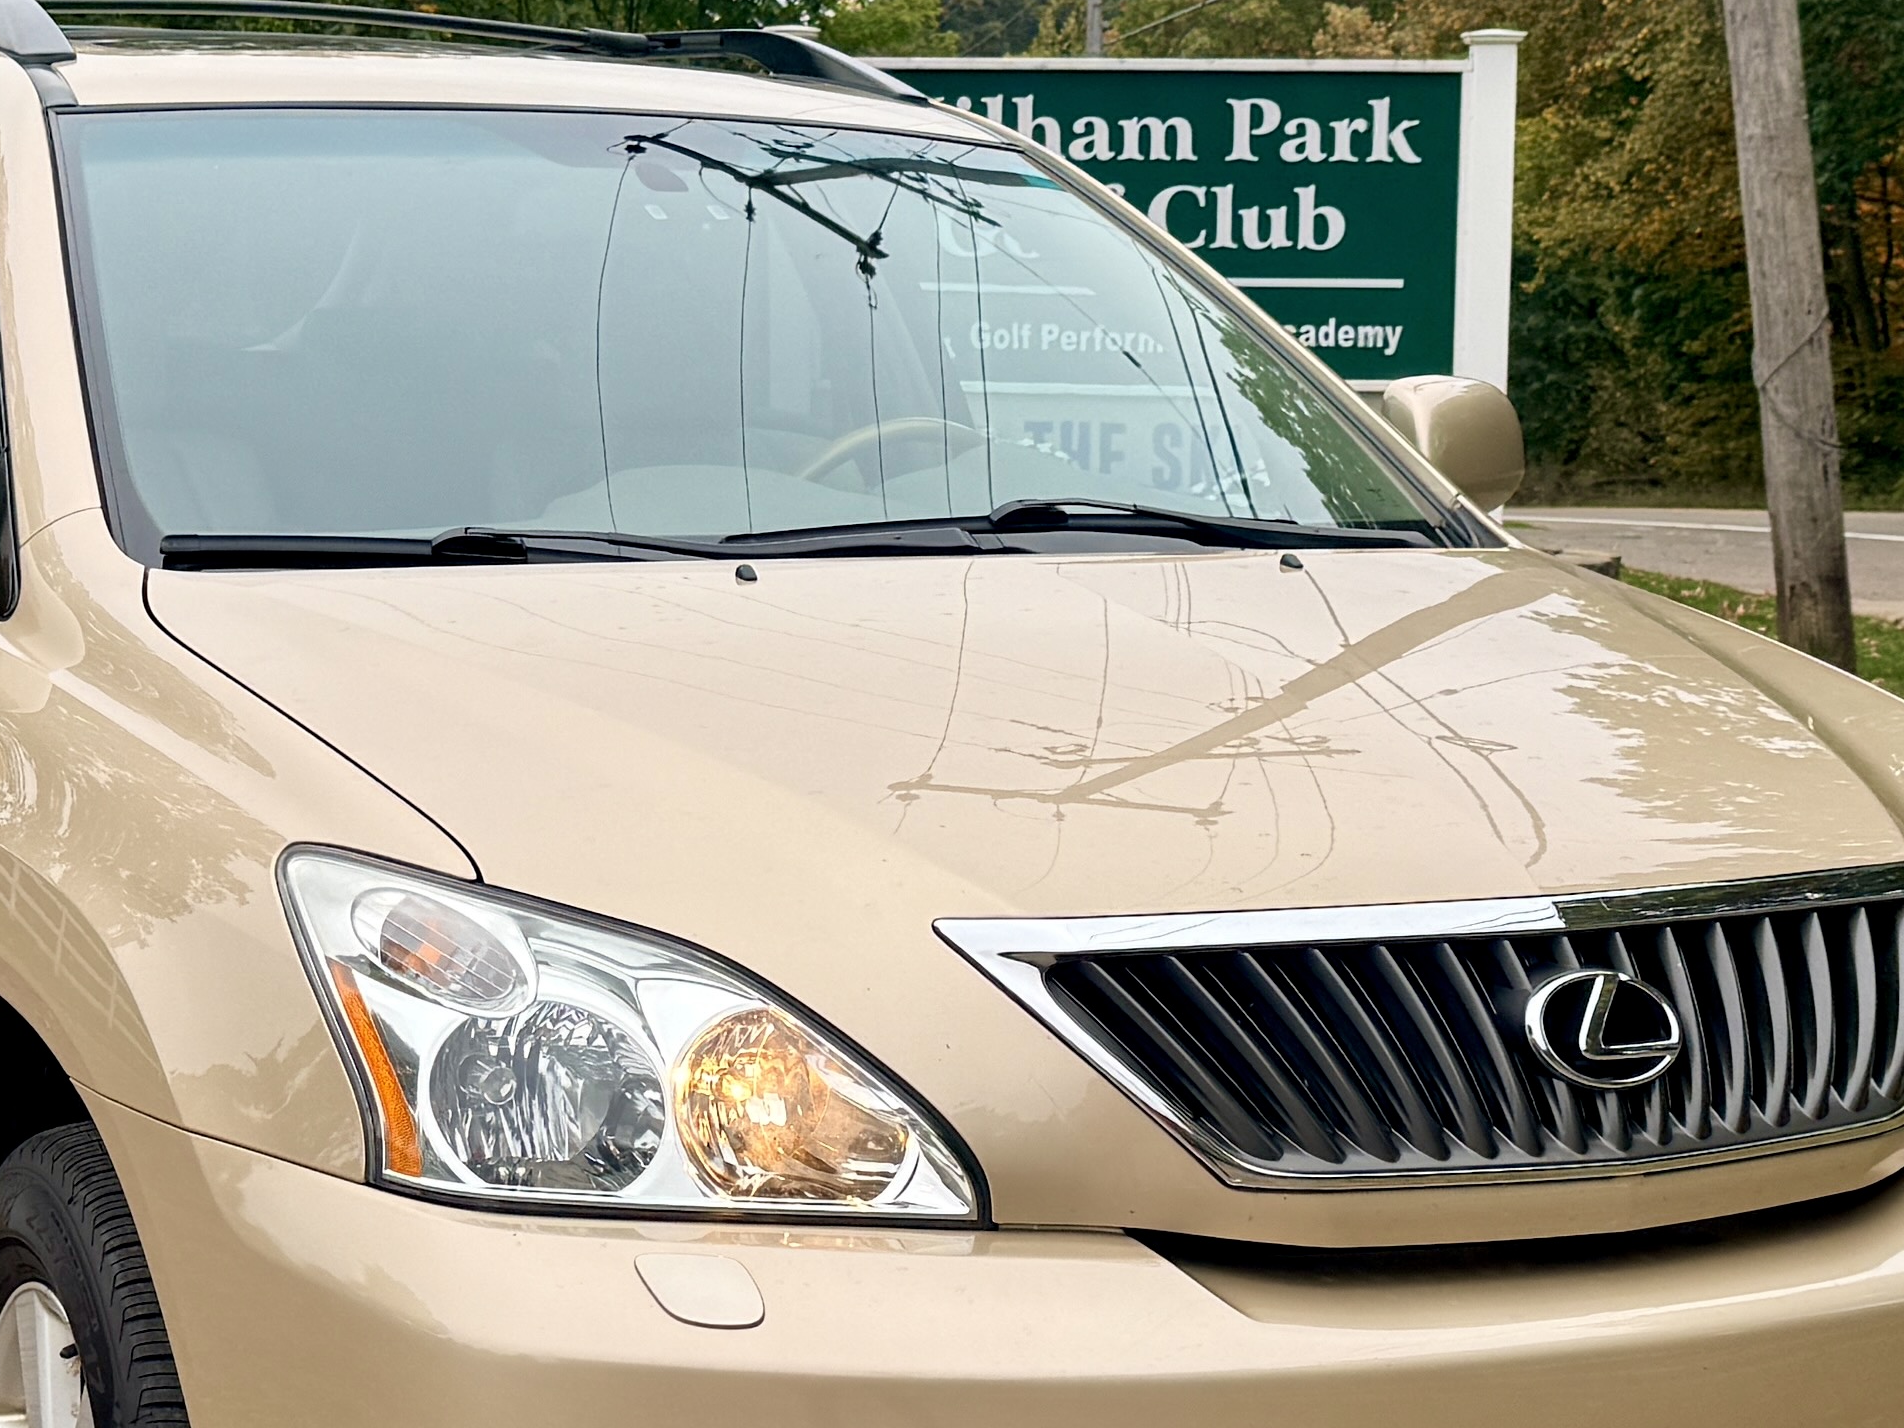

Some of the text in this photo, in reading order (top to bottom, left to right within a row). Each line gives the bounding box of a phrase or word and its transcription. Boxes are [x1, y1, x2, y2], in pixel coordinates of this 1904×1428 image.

[935, 93, 1422, 164] ham Park
[1147, 183, 1347, 252] Club
[969, 320, 1033, 351] Golf
